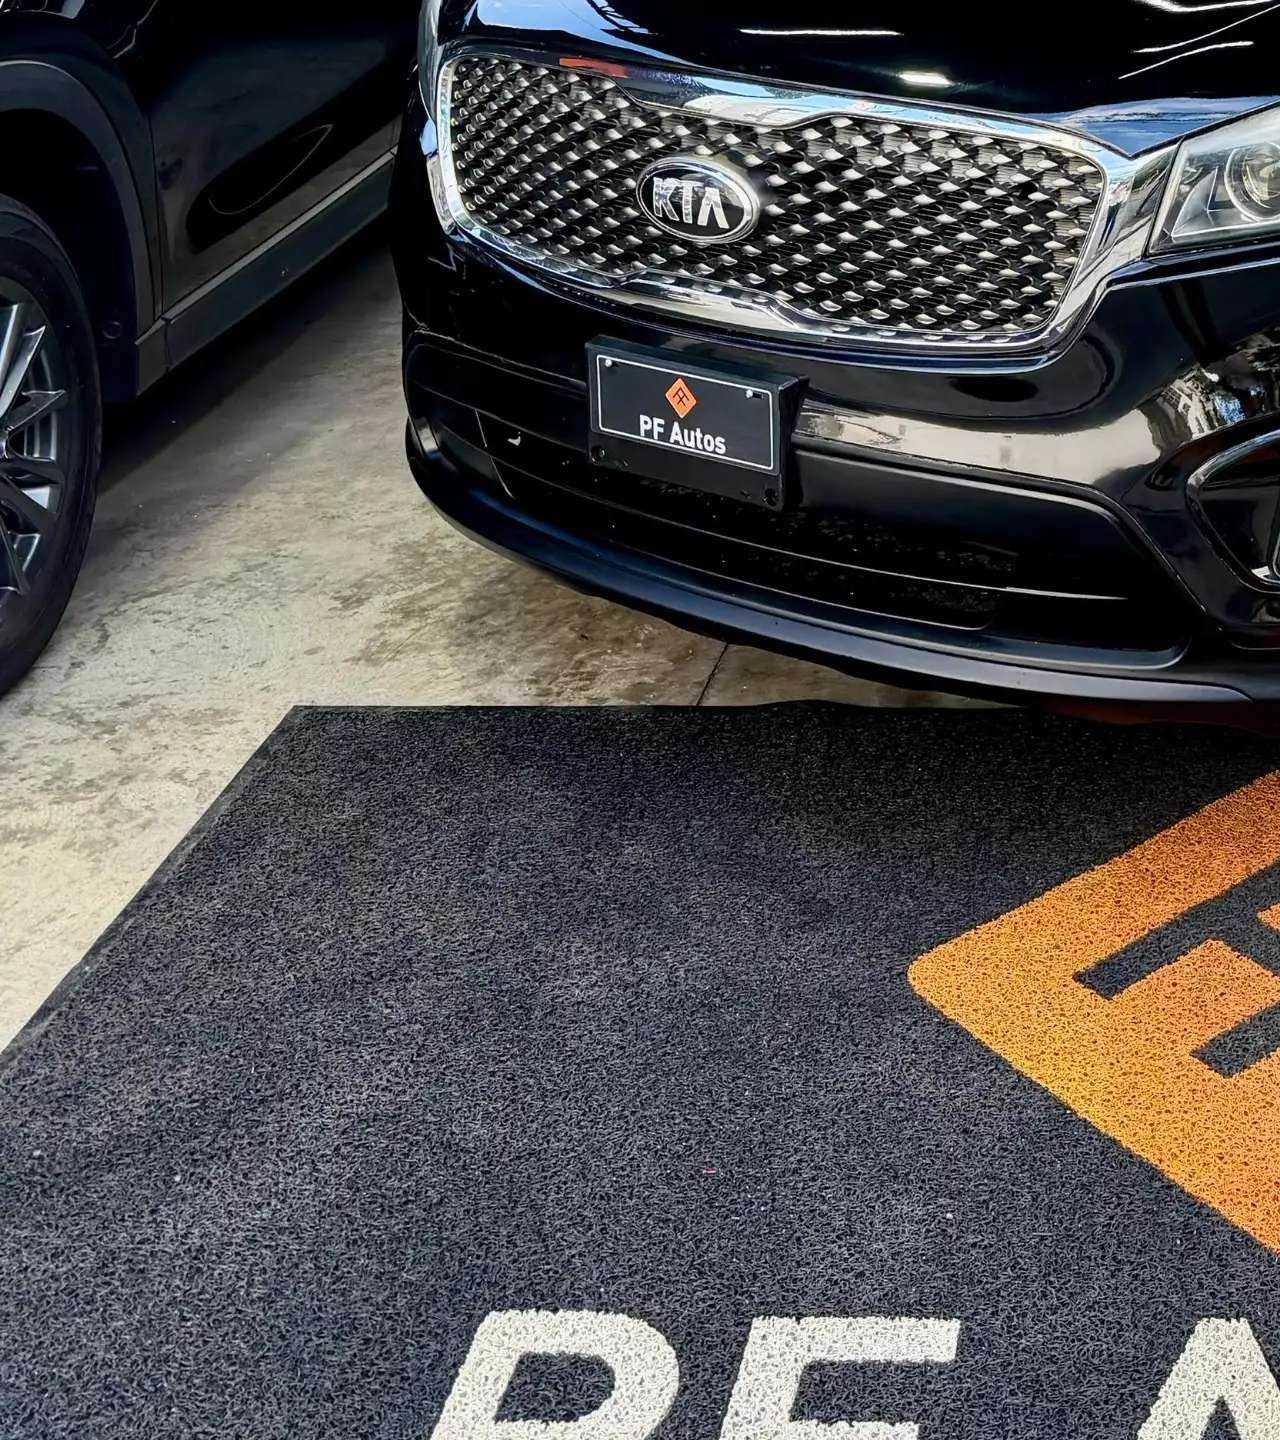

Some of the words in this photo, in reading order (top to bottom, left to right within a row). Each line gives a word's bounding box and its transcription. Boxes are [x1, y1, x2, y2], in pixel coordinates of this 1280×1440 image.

[652, 176, 730, 230] KIA
[640, 414, 665, 440] PF
[669, 421, 726, 455] Autos
